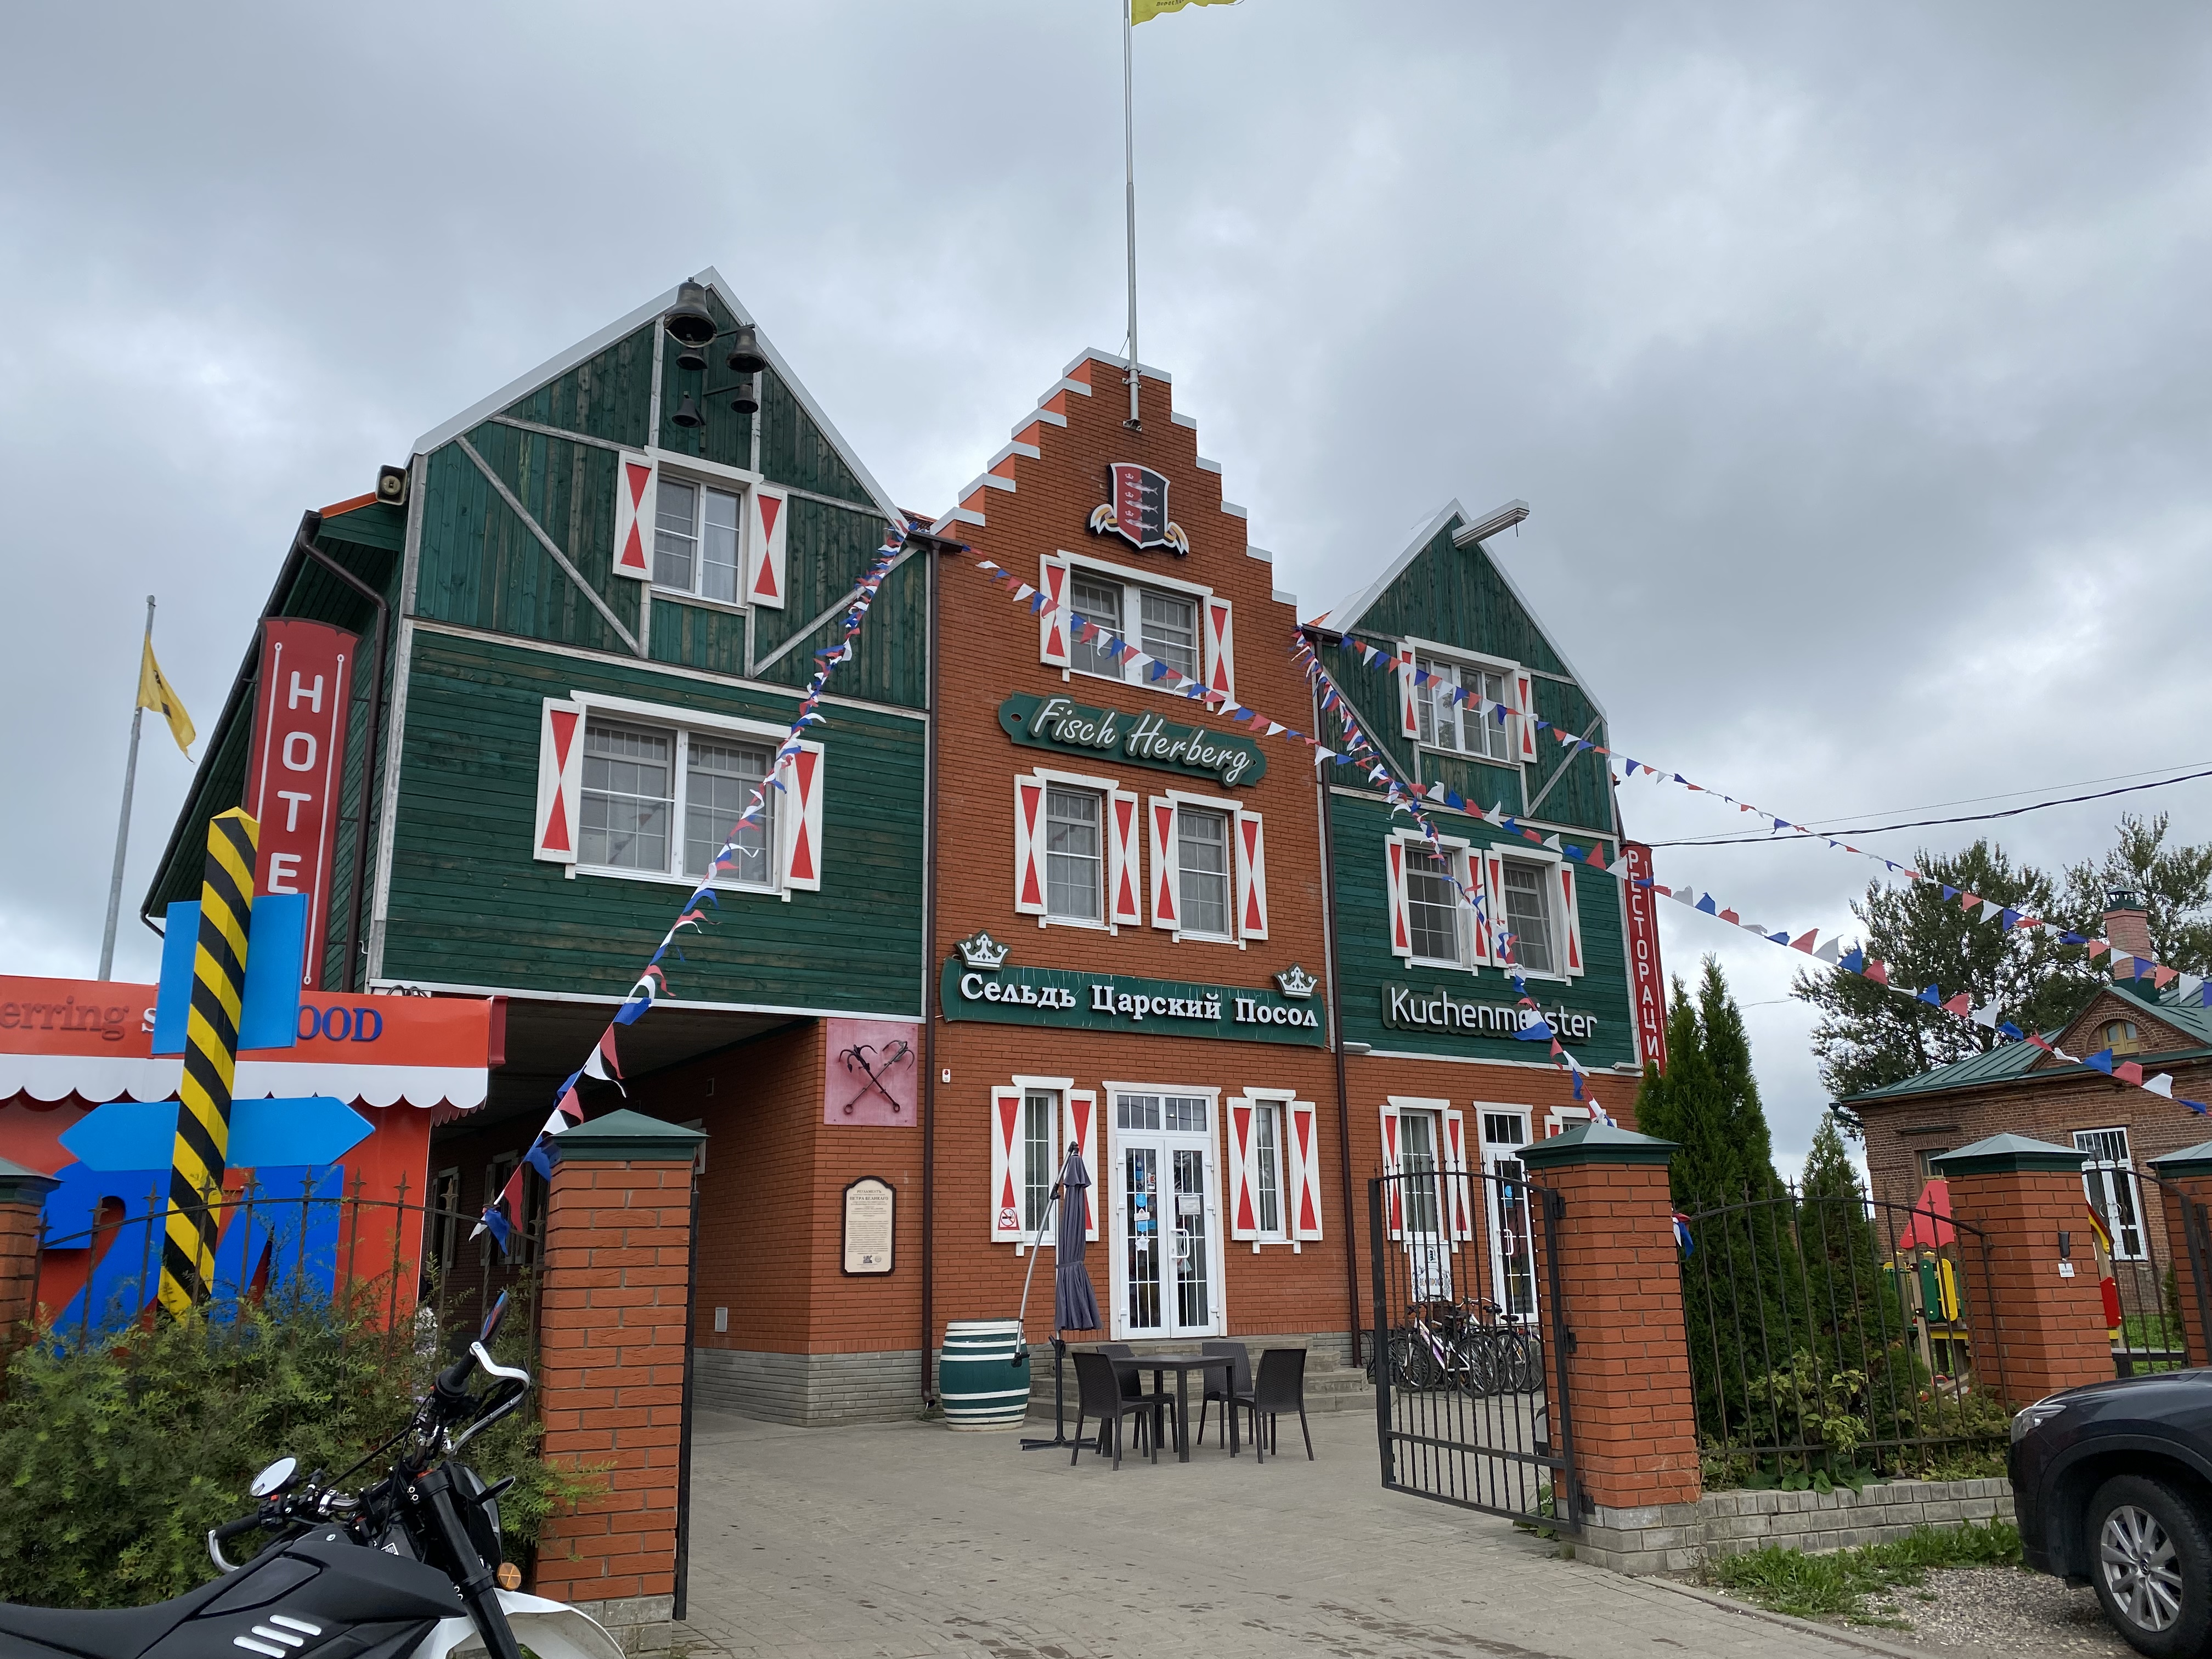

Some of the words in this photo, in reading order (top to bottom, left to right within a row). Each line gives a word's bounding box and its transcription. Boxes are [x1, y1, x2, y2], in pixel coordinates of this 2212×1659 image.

[1034, 698, 1116, 744] Fisch
[1129, 714, 1250, 783] Herberg
[267, 670, 324, 895] HOTE
[297, 1005, 383, 1041] OOD
[960, 973, 1076, 1009] Сельдь
[1091, 984, 1222, 1020] Царский
[1234, 997, 1318, 1027] Посол
[1391, 986, 1598, 1039] Kuchenmester
